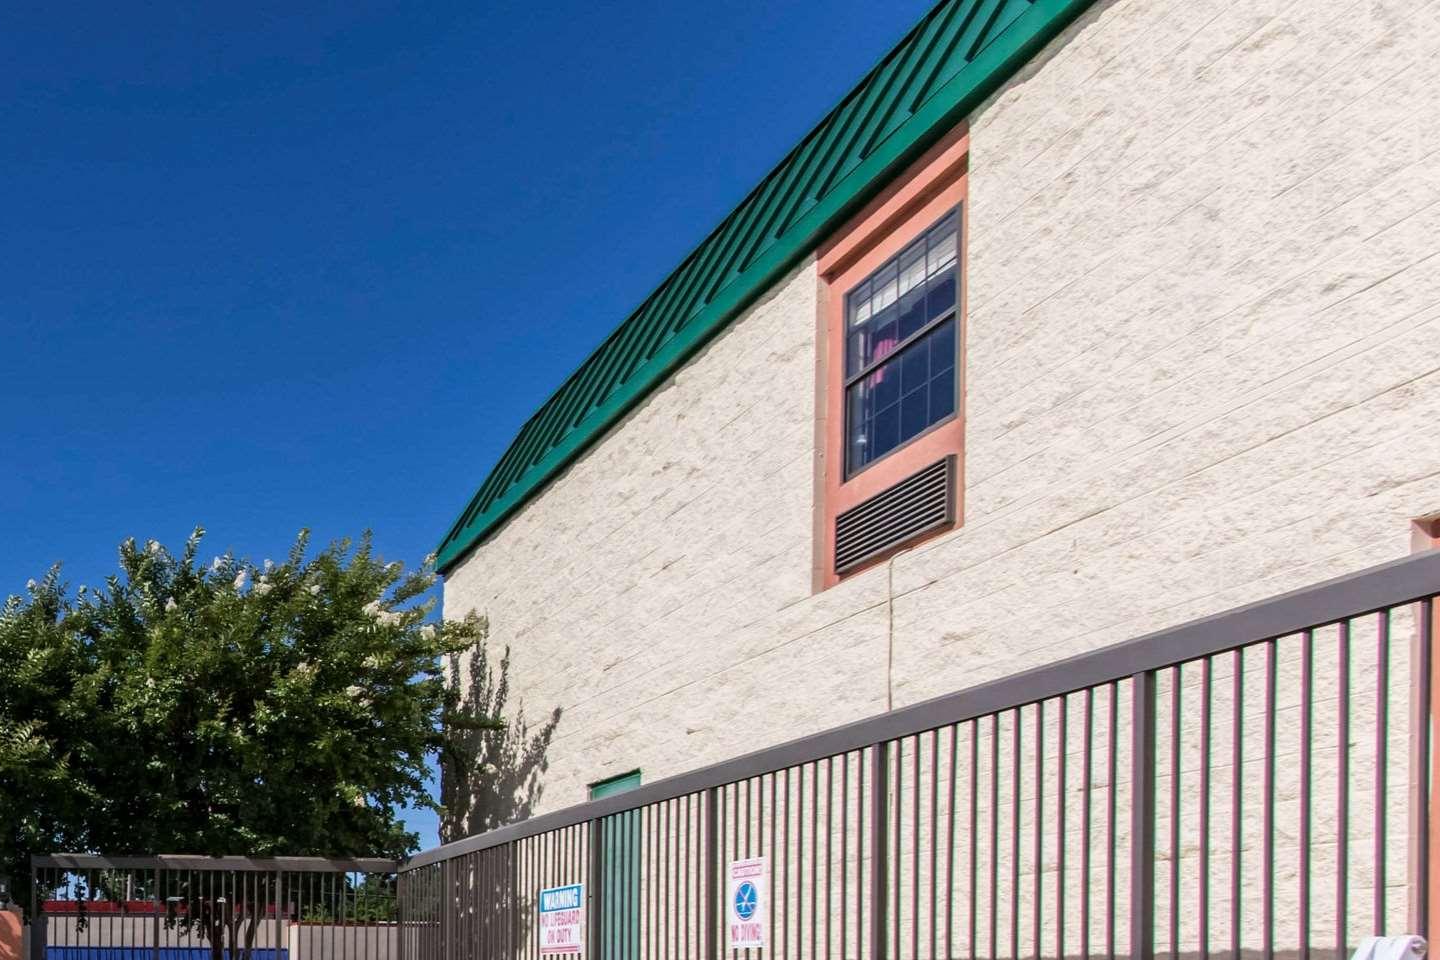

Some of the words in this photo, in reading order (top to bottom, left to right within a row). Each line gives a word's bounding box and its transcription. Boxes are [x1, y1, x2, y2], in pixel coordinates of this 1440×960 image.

[543, 887, 579, 911] WARNING
[551, 909, 580, 927] LIFEGUARD
[547, 929, 555, 944] ON
[557, 927, 572, 943] DUTY
